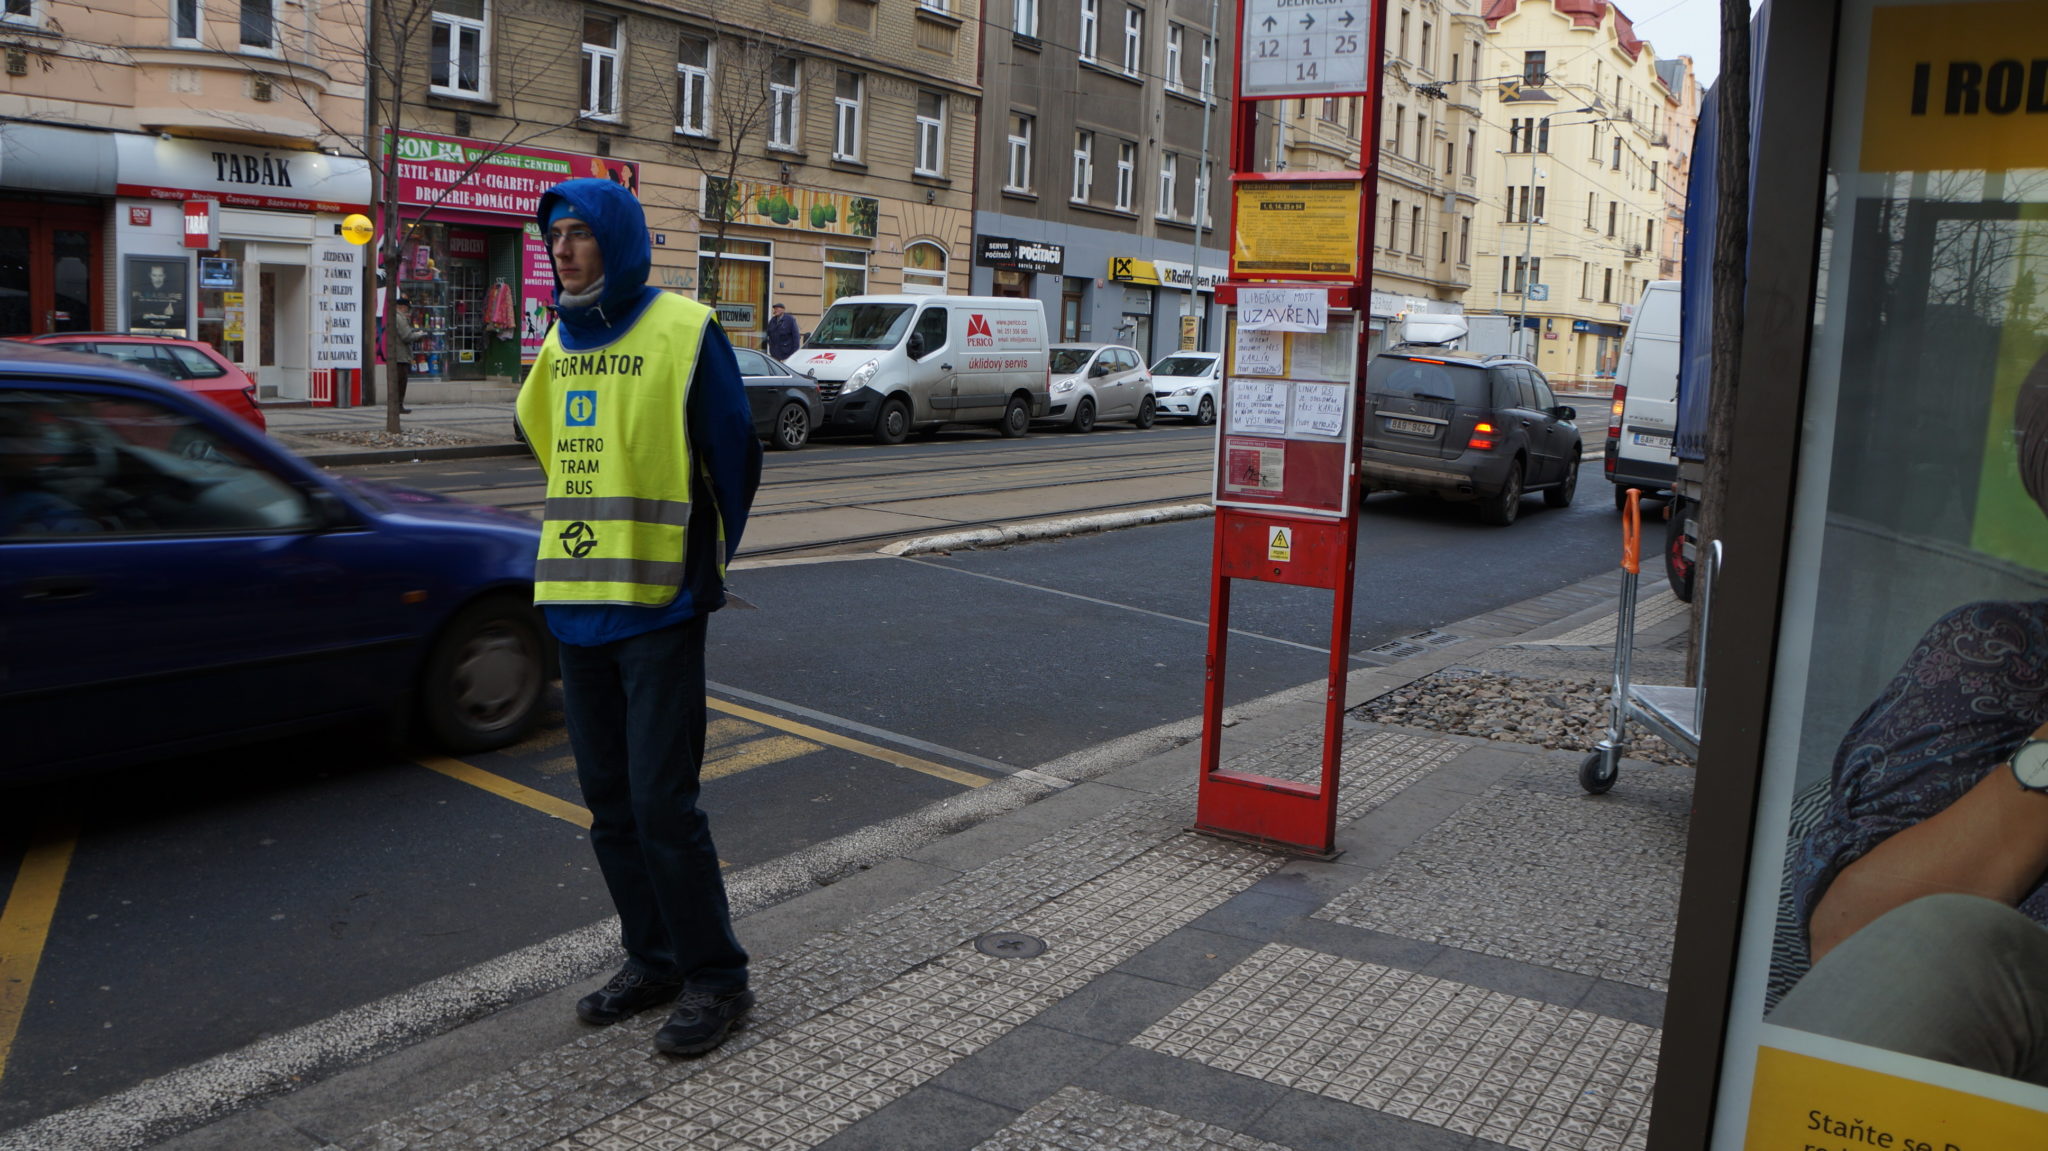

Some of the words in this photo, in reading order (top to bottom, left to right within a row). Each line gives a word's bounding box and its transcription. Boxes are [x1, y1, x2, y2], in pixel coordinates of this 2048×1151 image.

[1258, 39, 1279, 58] 12
[1303, 38, 1312, 56] 1
[1335, 35, 1357, 54] 25
[1296, 62, 1318, 81] 14
[1911, 62, 1931, 115] I
[212, 151, 292, 188] TABÁK
[524, 159, 568, 173] CENTRUM
[398, 163, 428, 180] EXTIL
[486, 174, 535, 193] CIGARETY
[151, 189, 184, 200] Cigarety
[226, 194, 260, 206] Časopisy
[316, 203, 340, 212] Nápoje
[475, 192, 513, 210] DOMÁCÍ
[185, 211, 208, 234] TABÁK
[989, 242, 1009, 250] SERVIS
[1018, 244, 1061, 264] POČÍTAČŮ
[323, 250, 354, 263] JÍZDENKY
[323, 285, 353, 296] PHLEDY
[1244, 290, 1285, 305] LIBEŇSKÝ
[1294, 292, 1316, 303] MOST
[335, 302, 356, 312] KARTY
[1243, 304, 1320, 326] UZAVŘEN
[967, 337, 993, 347] PERICO
[968, 357, 1003, 371] úklidový
[1004, 357, 1028, 368] servis
[557, 437, 604, 453] METRO
[560, 459, 599, 474] TRAM
[566, 480, 593, 496] BUS
[1807, 1109, 1893, 1149] Staňte
